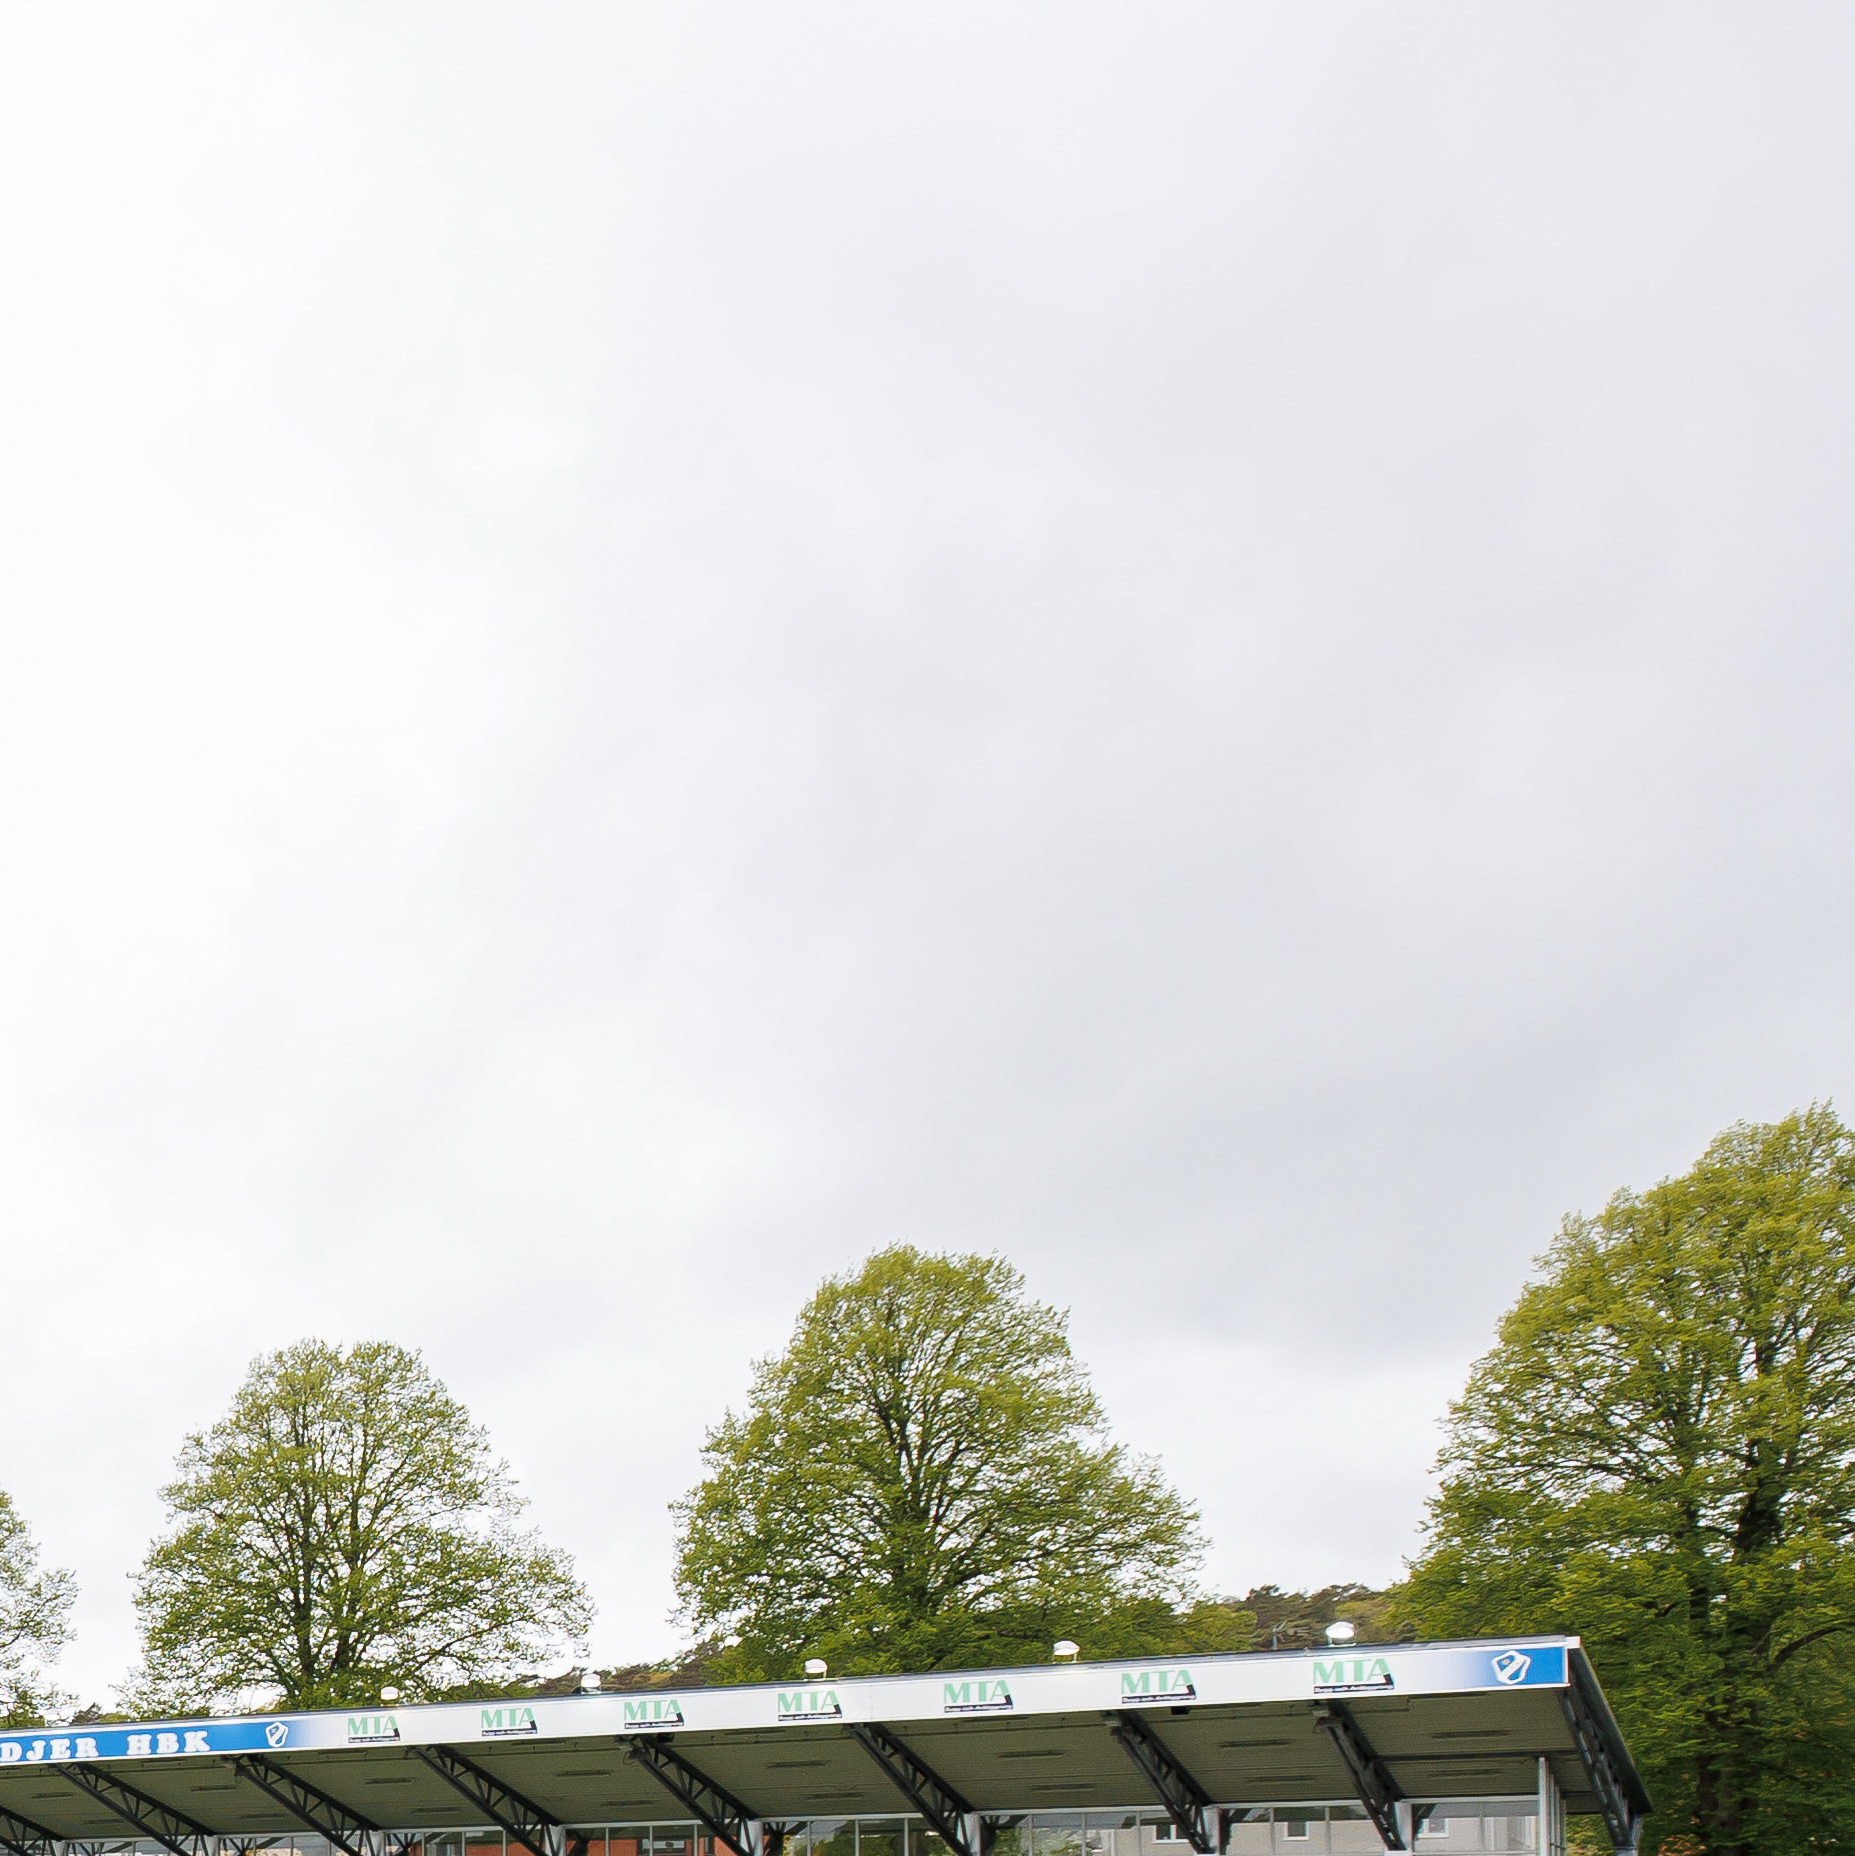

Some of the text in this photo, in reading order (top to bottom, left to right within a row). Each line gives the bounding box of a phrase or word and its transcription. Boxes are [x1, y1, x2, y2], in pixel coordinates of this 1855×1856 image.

[1122, 1669, 1193, 1693] MTA
[1313, 1659, 1390, 1683] MTA
[779, 1691, 840, 1712] MTA
[945, 1680, 1009, 1703] MTA
[481, 1708, 536, 1728] MTA
[624, 1700, 682, 1720] MTA
[348, 1717, 397, 1735] MTA
[127, 1730, 211, 1755] HBK
